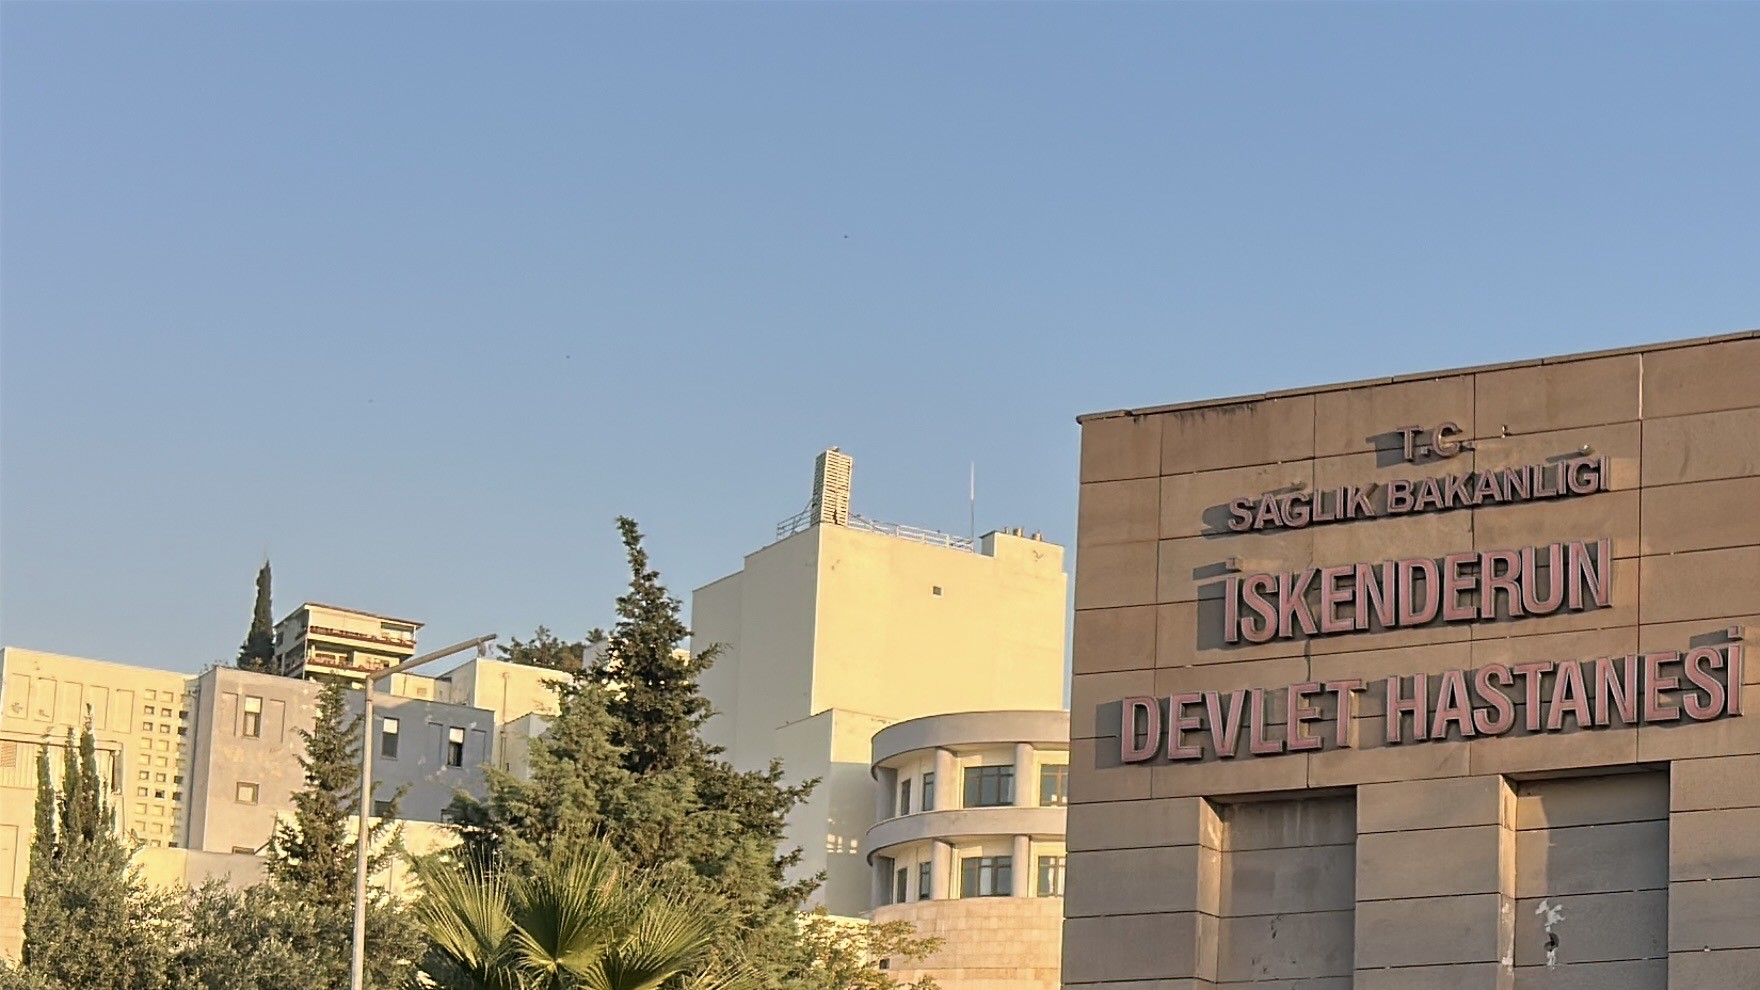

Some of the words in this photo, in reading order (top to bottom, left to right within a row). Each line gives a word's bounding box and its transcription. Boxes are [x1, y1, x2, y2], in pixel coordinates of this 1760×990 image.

[1396, 421, 1473, 462] T.C.
[1224, 538, 1612, 645] İSKENDERUN
[1120, 678, 1367, 766] DEVLET
[1386, 626, 1744, 744] HASTANESİ
